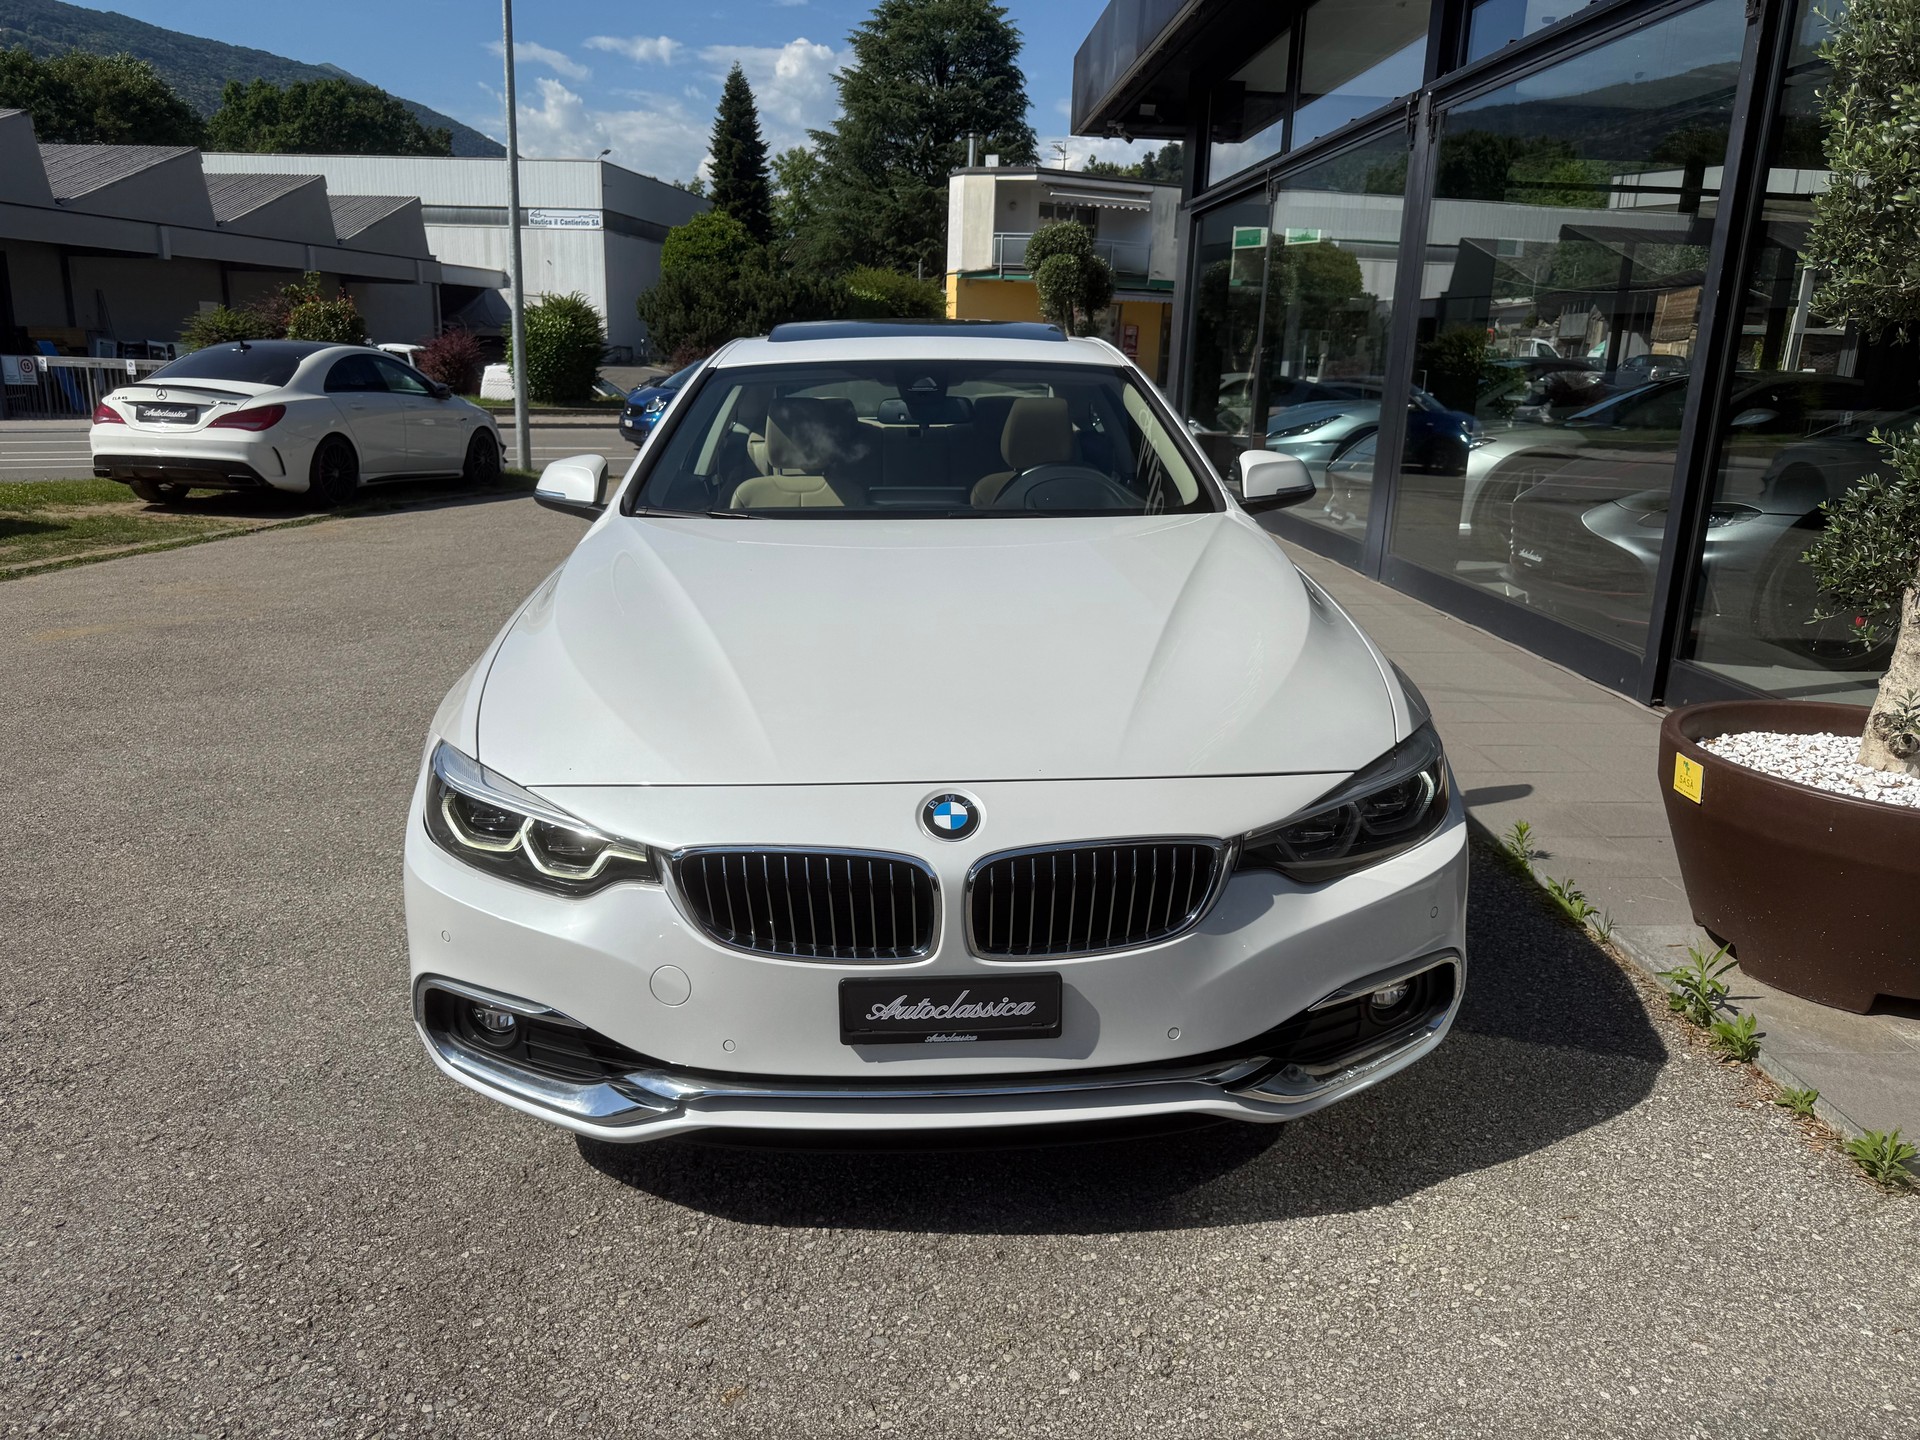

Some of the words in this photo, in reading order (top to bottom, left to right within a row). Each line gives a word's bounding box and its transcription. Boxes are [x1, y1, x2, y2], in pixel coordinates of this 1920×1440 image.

[143, 408, 188, 418] Autoclassica
[1679, 774, 1694, 790] SASA
[928, 794, 974, 810] BMW
[866, 990, 1037, 1020] Autoclassica
[925, 1033, 977, 1043] Autoclassica
